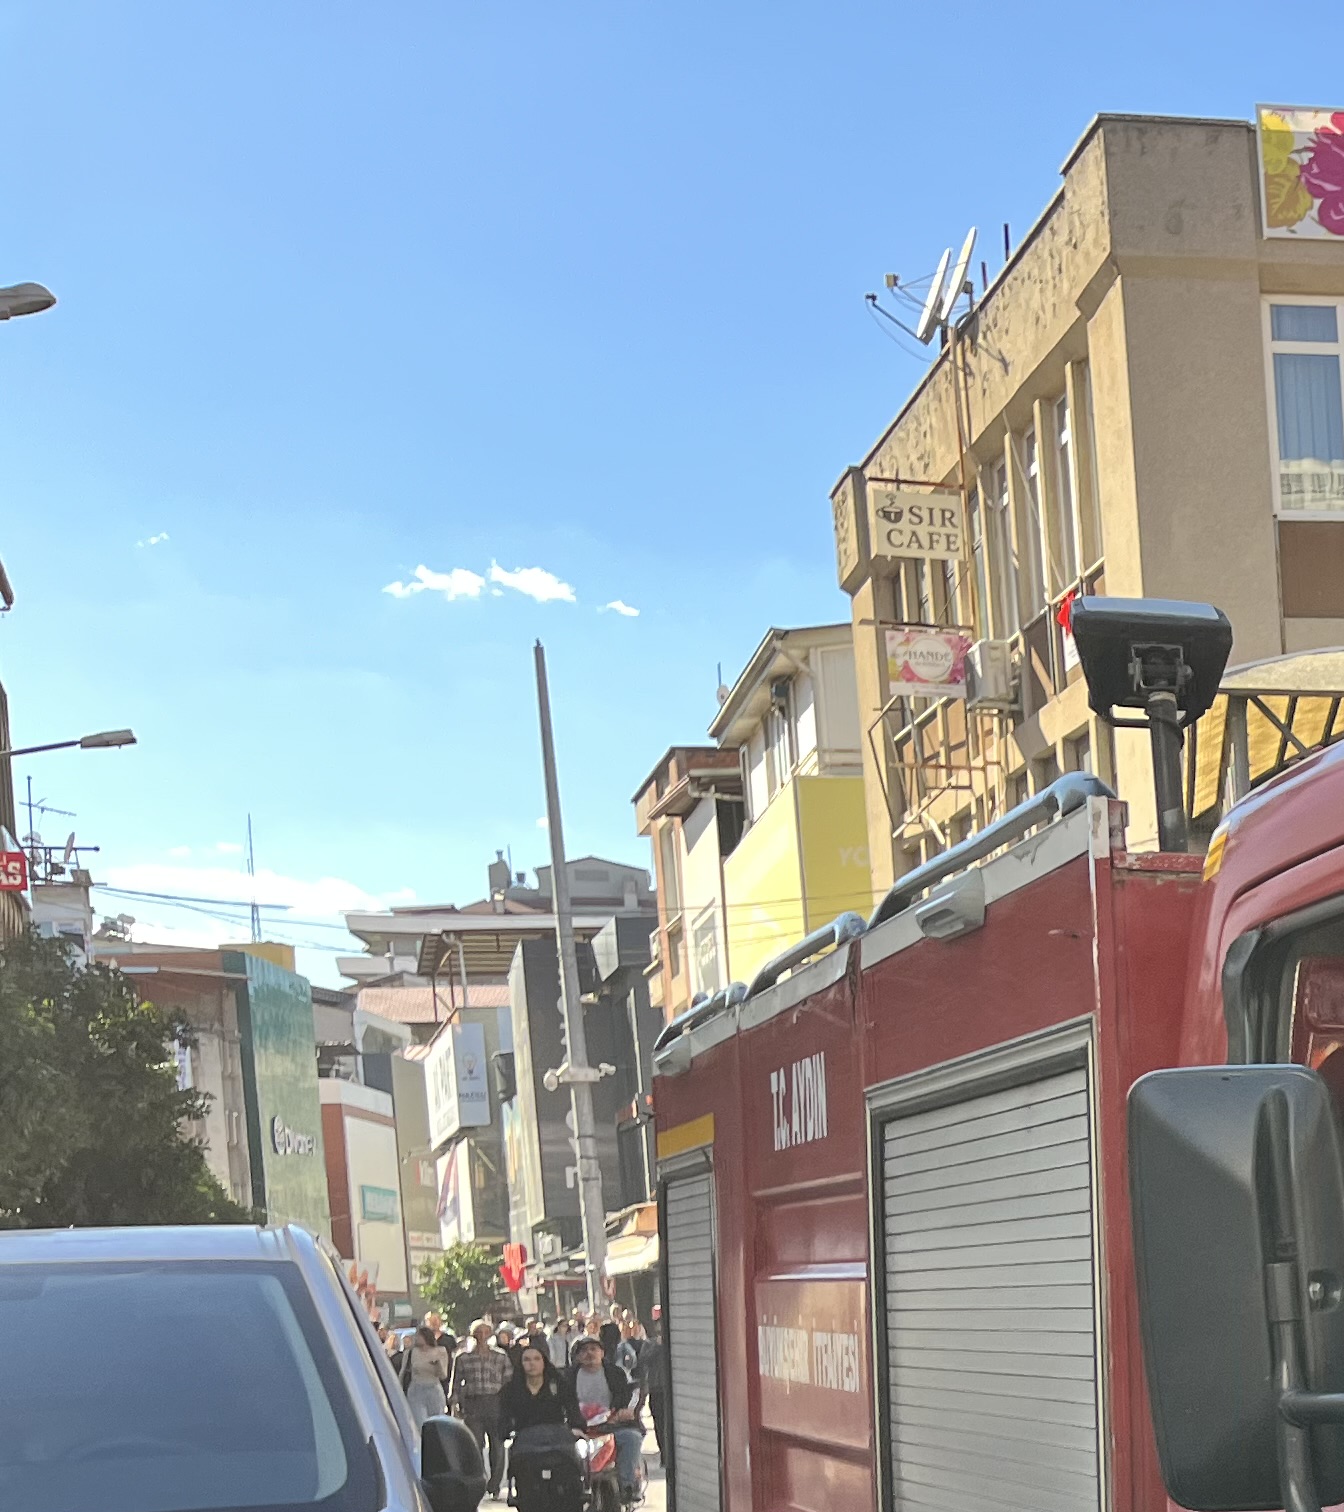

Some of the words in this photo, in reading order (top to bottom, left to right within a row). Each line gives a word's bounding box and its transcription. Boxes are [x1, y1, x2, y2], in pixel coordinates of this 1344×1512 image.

[908, 505, 959, 529] SIR
[886, 527, 961, 553] CAFE
[792, 1051, 828, 1146] AYDIN
